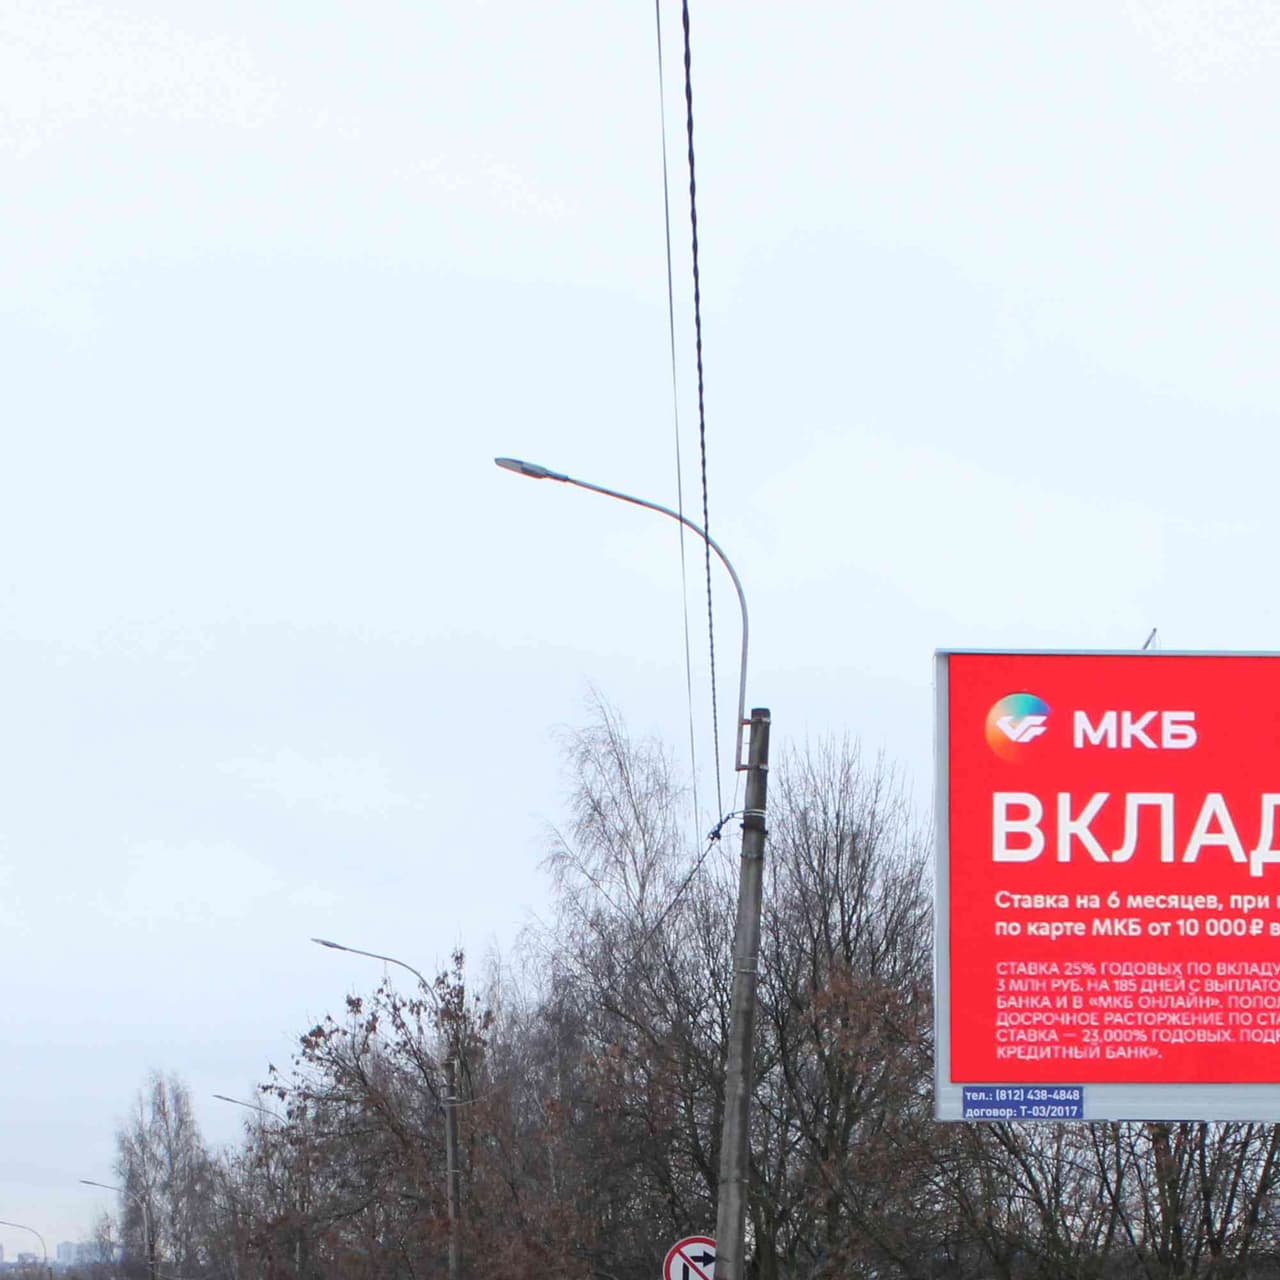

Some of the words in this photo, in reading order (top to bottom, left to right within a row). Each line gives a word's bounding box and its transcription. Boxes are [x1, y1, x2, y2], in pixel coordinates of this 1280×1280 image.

[1073, 710, 1197, 749] МКБ
[995, 890, 1069, 908] Ставка
[1076, 894, 1100, 908] на
[1107, 890, 1120, 908] 6
[1127, 894, 1223, 912] месяцев,
[1230, 894, 1270, 913] при
[995, 922, 1021, 937] по
[1027, 922, 1086, 941] карте
[1092, 919, 1142, 937] МКБ
[1148, 922, 1172, 937] от
[1177, 919, 1200, 937] 10
[996, 962, 1059, 975] СТАВКА
[1064, 962, 1096, 975] 25%
[1101, 962, 1182, 978] ГОДОВЫХ
[1187, 962, 1211, 975] ПО
[997, 979, 1005, 992] 3
[1009, 979, 1046, 992] МЛН
[1051, 979, 1083, 992] РУБ.
[1087, 979, 1110, 992] НА
[1113, 979, 1137, 992] 185
[1140, 976, 1185, 995] ДНЕЙ
[1189, 979, 1200, 992] С
[997, 996, 1052, 1009] БАНКА
[1056, 996, 1067, 1009] И
[1072, 996, 1083, 1009] В
[1089, 996, 1133, 1009] «МКБ
[1138, 993, 1223, 1009] ОНЛАЙН».
[996, 1012, 1100, 1028] ДОСРОЧНОЕ
[1104, 1013, 1224, 1026] РАСТОРЖЕНИЕ
[1229, 1013, 1253, 1026] ПО
[996, 1029, 1059, 1042] СТАВКА
[1152, 1029, 1235, 1045] ГОДОВЫХ.
[997, 1043, 1100, 1062] КРЕДИТНЫЙ
[1106, 1046, 1162, 1059] БАНК».
[965, 1091, 993, 1100] тел.:
[996, 1089, 1024, 1101] (812)
[1027, 1090, 1080, 1100] 438-4848
[966, 1108, 1017, 1119] договор:
